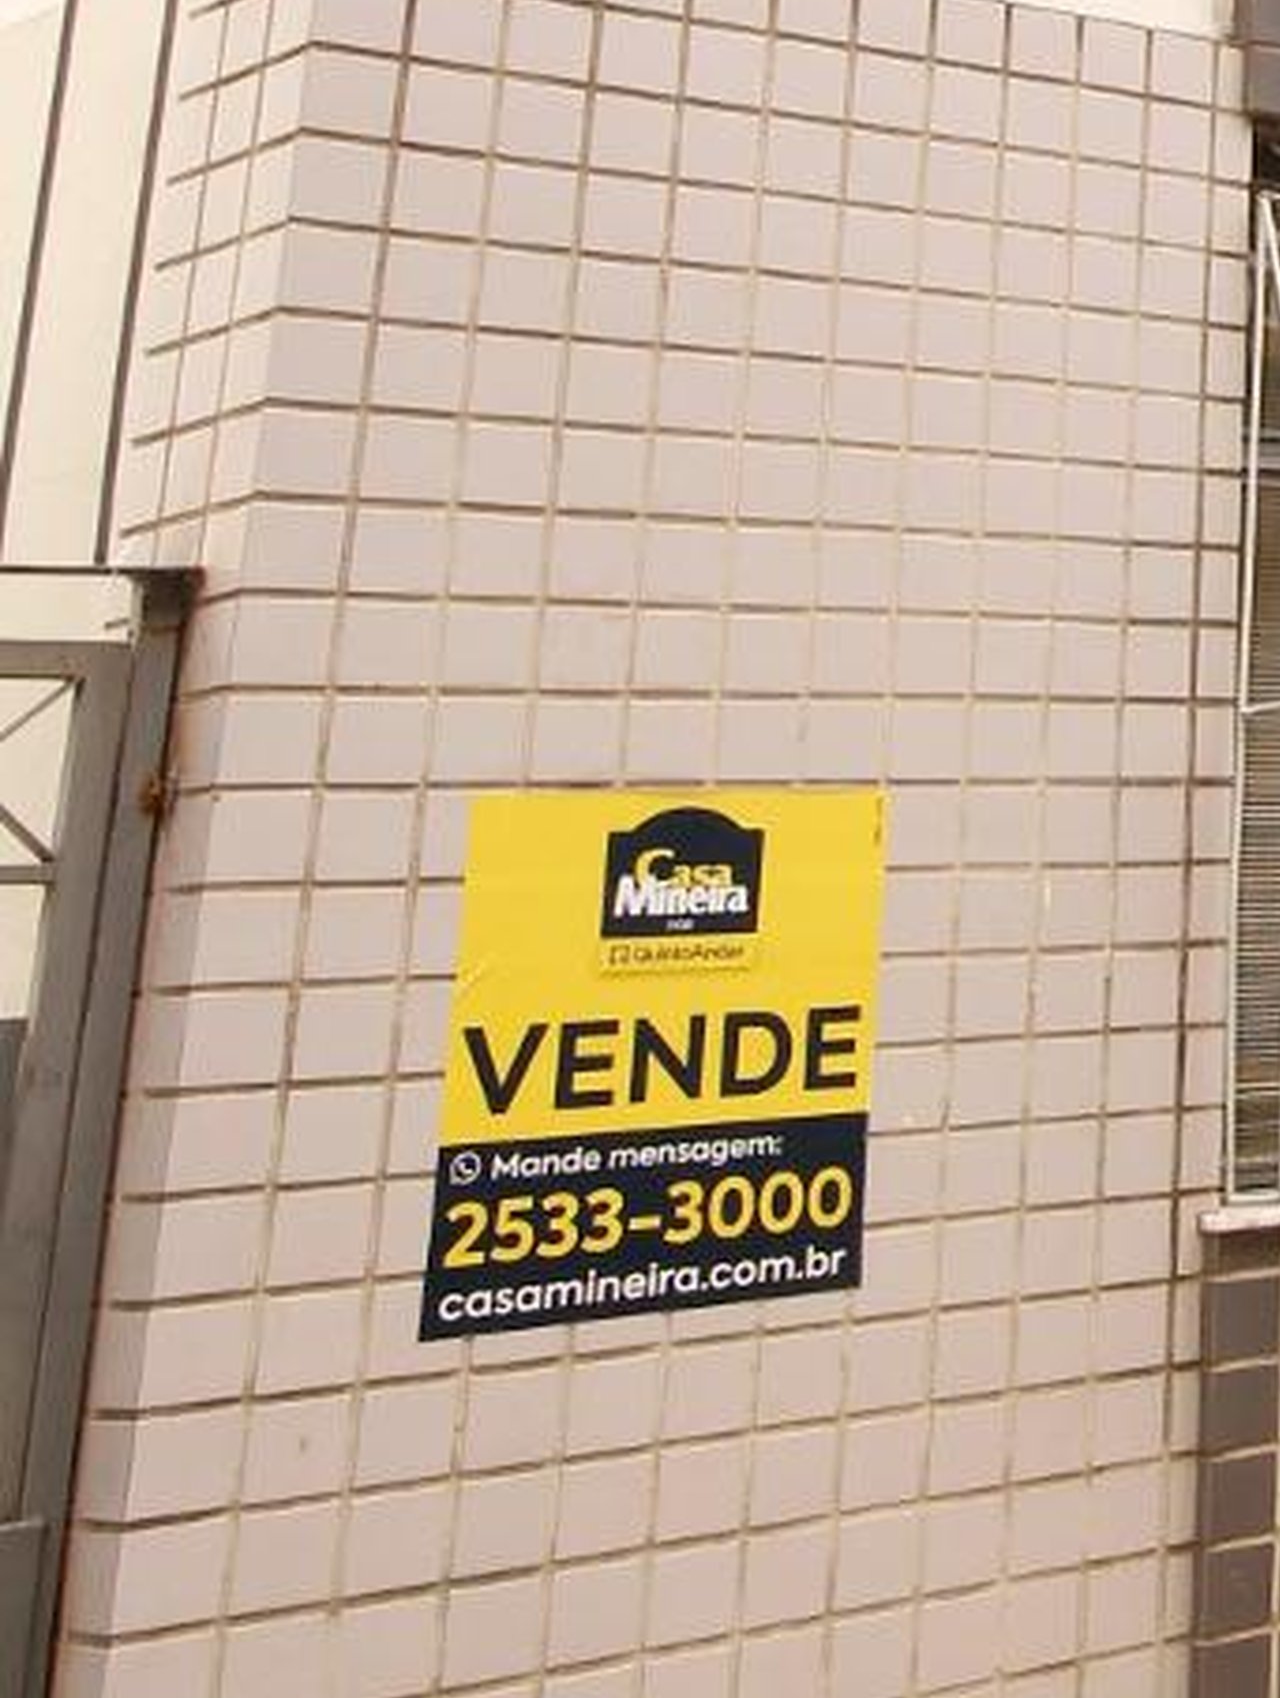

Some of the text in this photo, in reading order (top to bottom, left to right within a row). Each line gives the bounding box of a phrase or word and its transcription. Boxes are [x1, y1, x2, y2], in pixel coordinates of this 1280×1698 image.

[613, 874, 749, 918] Mineira
[634, 848, 733, 888] Casa
[462, 1005, 861, 1115] VENDE
[491, 1134, 783, 1181] Mande mensagem:
[441, 1164, 853, 1269] 2533-3000
[438, 1242, 847, 1321] casamineira.com.br
